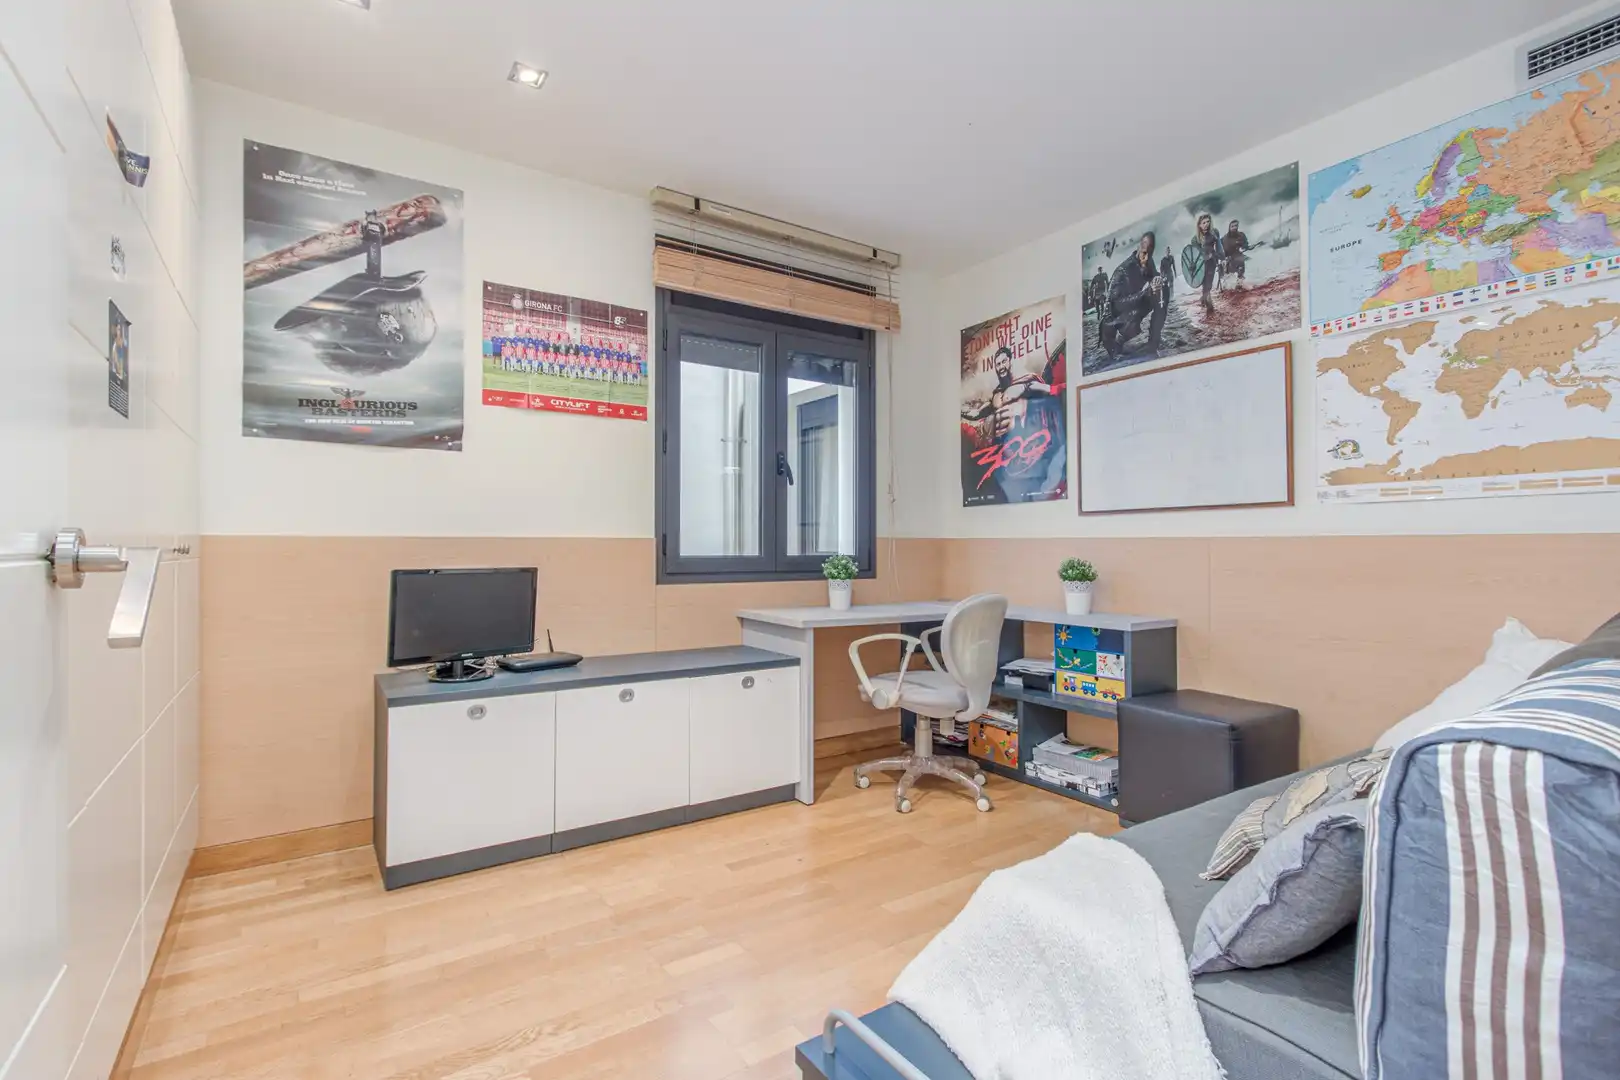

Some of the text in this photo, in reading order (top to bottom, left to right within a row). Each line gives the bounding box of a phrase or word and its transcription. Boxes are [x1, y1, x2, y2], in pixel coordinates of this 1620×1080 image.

[1329, 239, 1362, 253] EUROPE
[524, 299, 563, 312] GIRONA FC
[982, 354, 994, 372] IN
[312, 408, 407, 418] BASTERDS
[970, 428, 1052, 491] 300
